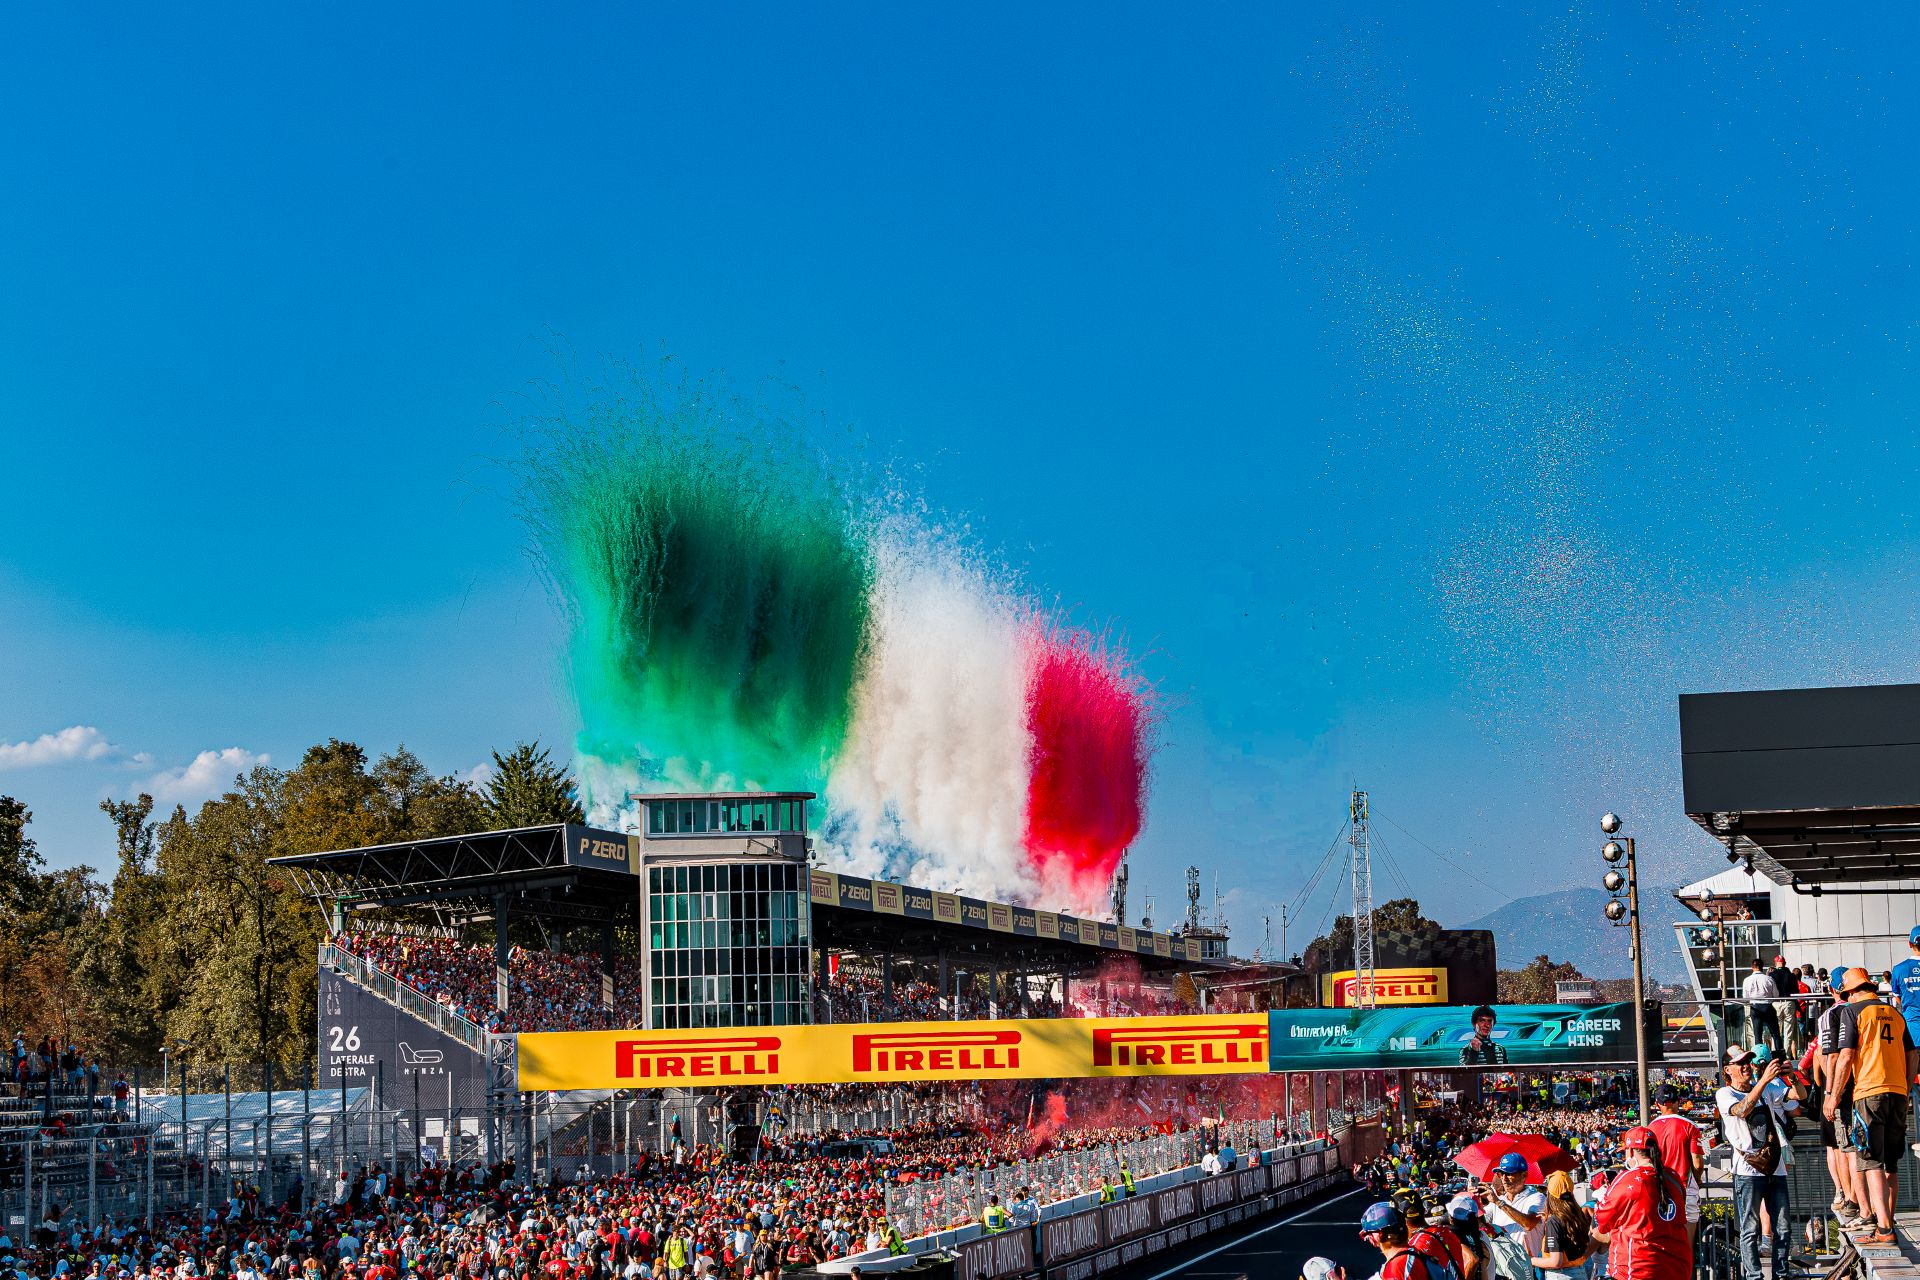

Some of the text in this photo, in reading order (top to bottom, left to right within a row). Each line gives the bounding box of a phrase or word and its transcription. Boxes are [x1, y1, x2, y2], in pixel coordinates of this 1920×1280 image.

[580, 838, 626, 861] P ZERO
[840, 884, 870, 901] P ZERO
[877, 886, 898, 909] PIRELLI
[911, 896, 931, 910] ZERO
[937, 897, 957, 918] PIRELLI
[968, 906, 986, 920] ZERO
[330, 1026, 361, 1051] 26
[1543, 1019, 1621, 1047] 7 CAREER
[1567, 1035, 1604, 1047] WINS
[1880, 1024, 1894, 1044] 4
[853, 1031, 1021, 1071] PIRELLI
[1093, 1025, 1267, 1065] PIRELLI
[331, 1055, 375, 1064] LATERALE
[616, 1037, 781, 1077] PIRELLI
[1049, 1213, 1098, 1261] QATAR AIRWAYS
[966, 1233, 1026, 1280] QATAR AIRWAYS
